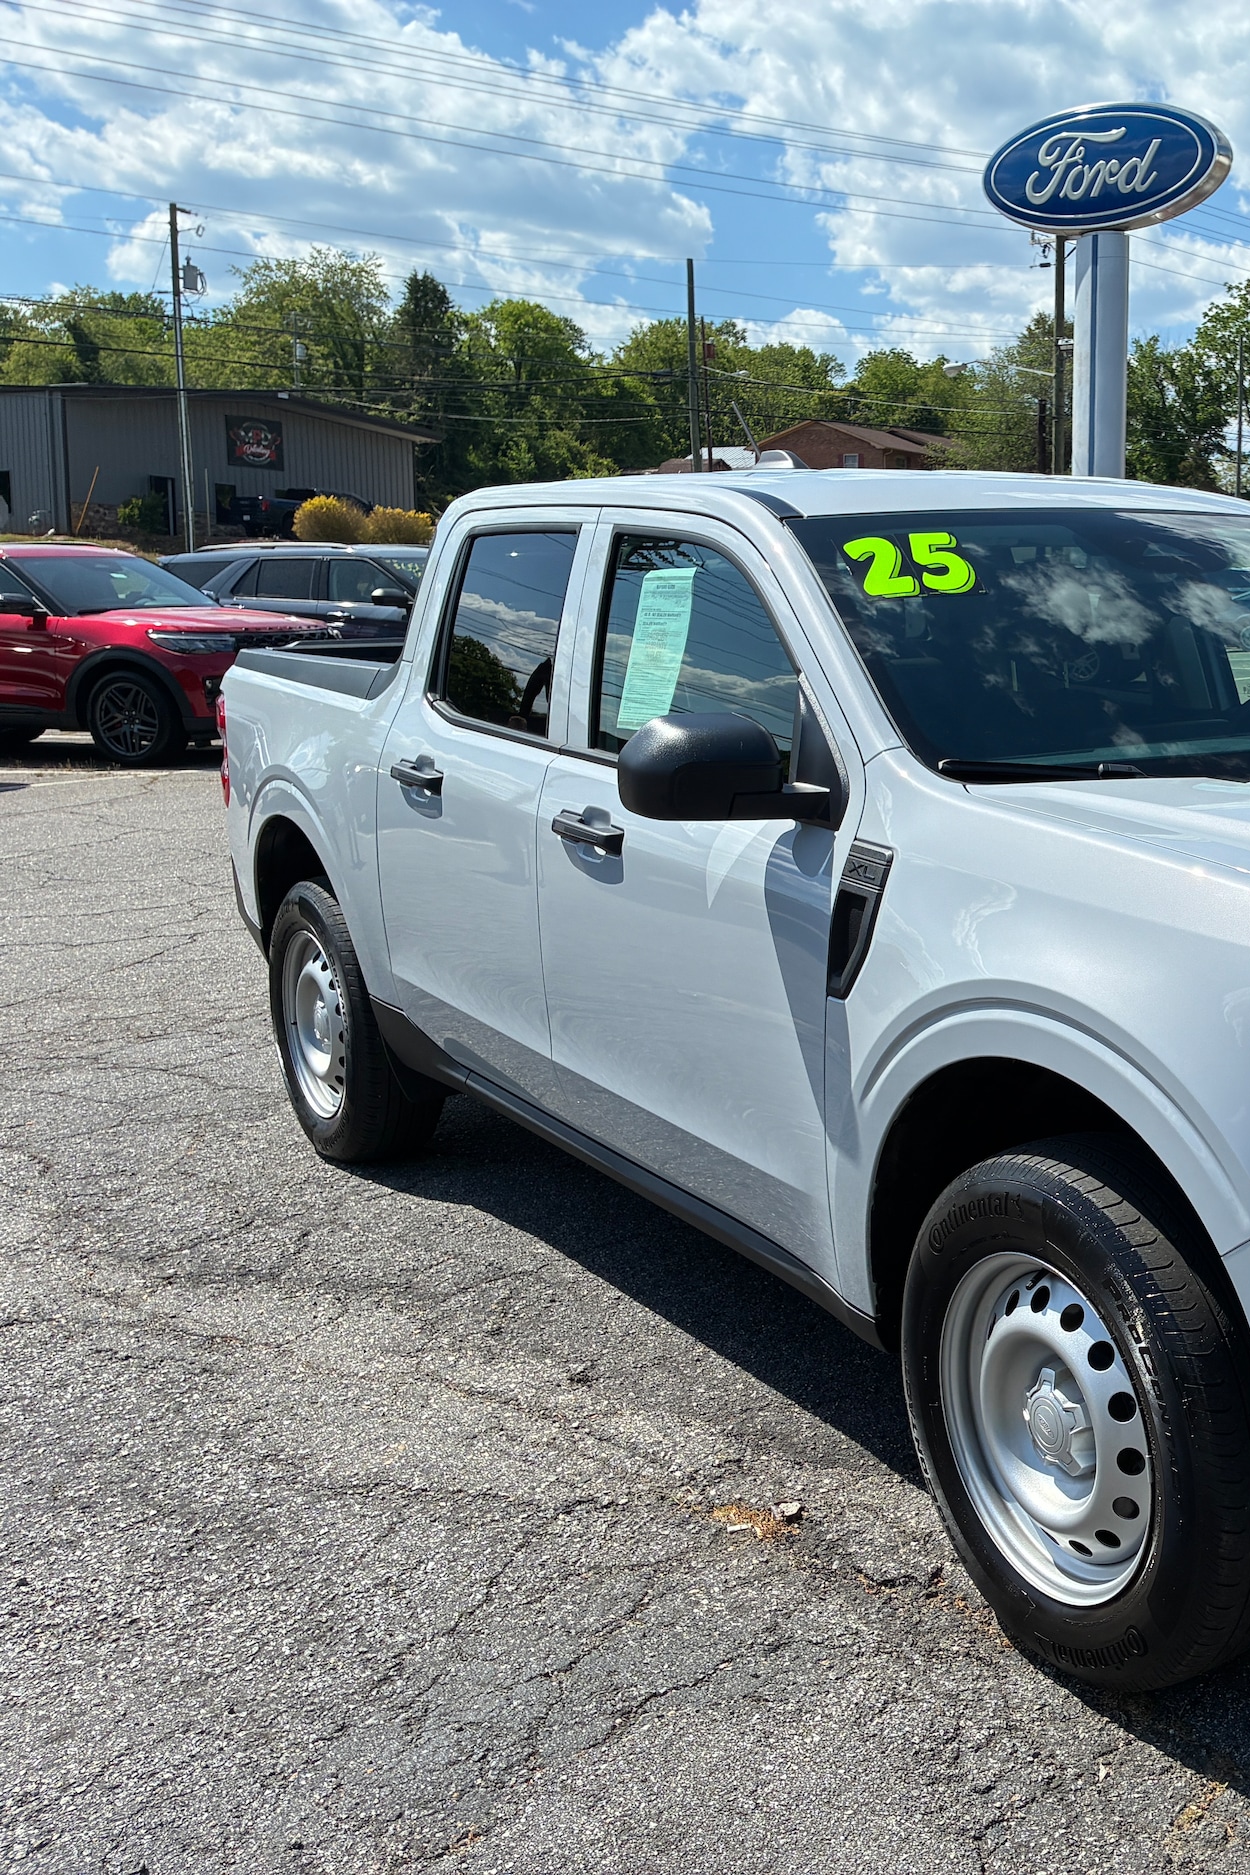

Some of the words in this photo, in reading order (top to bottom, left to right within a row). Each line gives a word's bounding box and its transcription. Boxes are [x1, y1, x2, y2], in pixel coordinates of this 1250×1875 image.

[1025, 126, 1162, 206] Ford
[843, 532, 976, 598] 25
[848, 860, 876, 880] XL
[928, 1191, 1010, 1256] Continental
